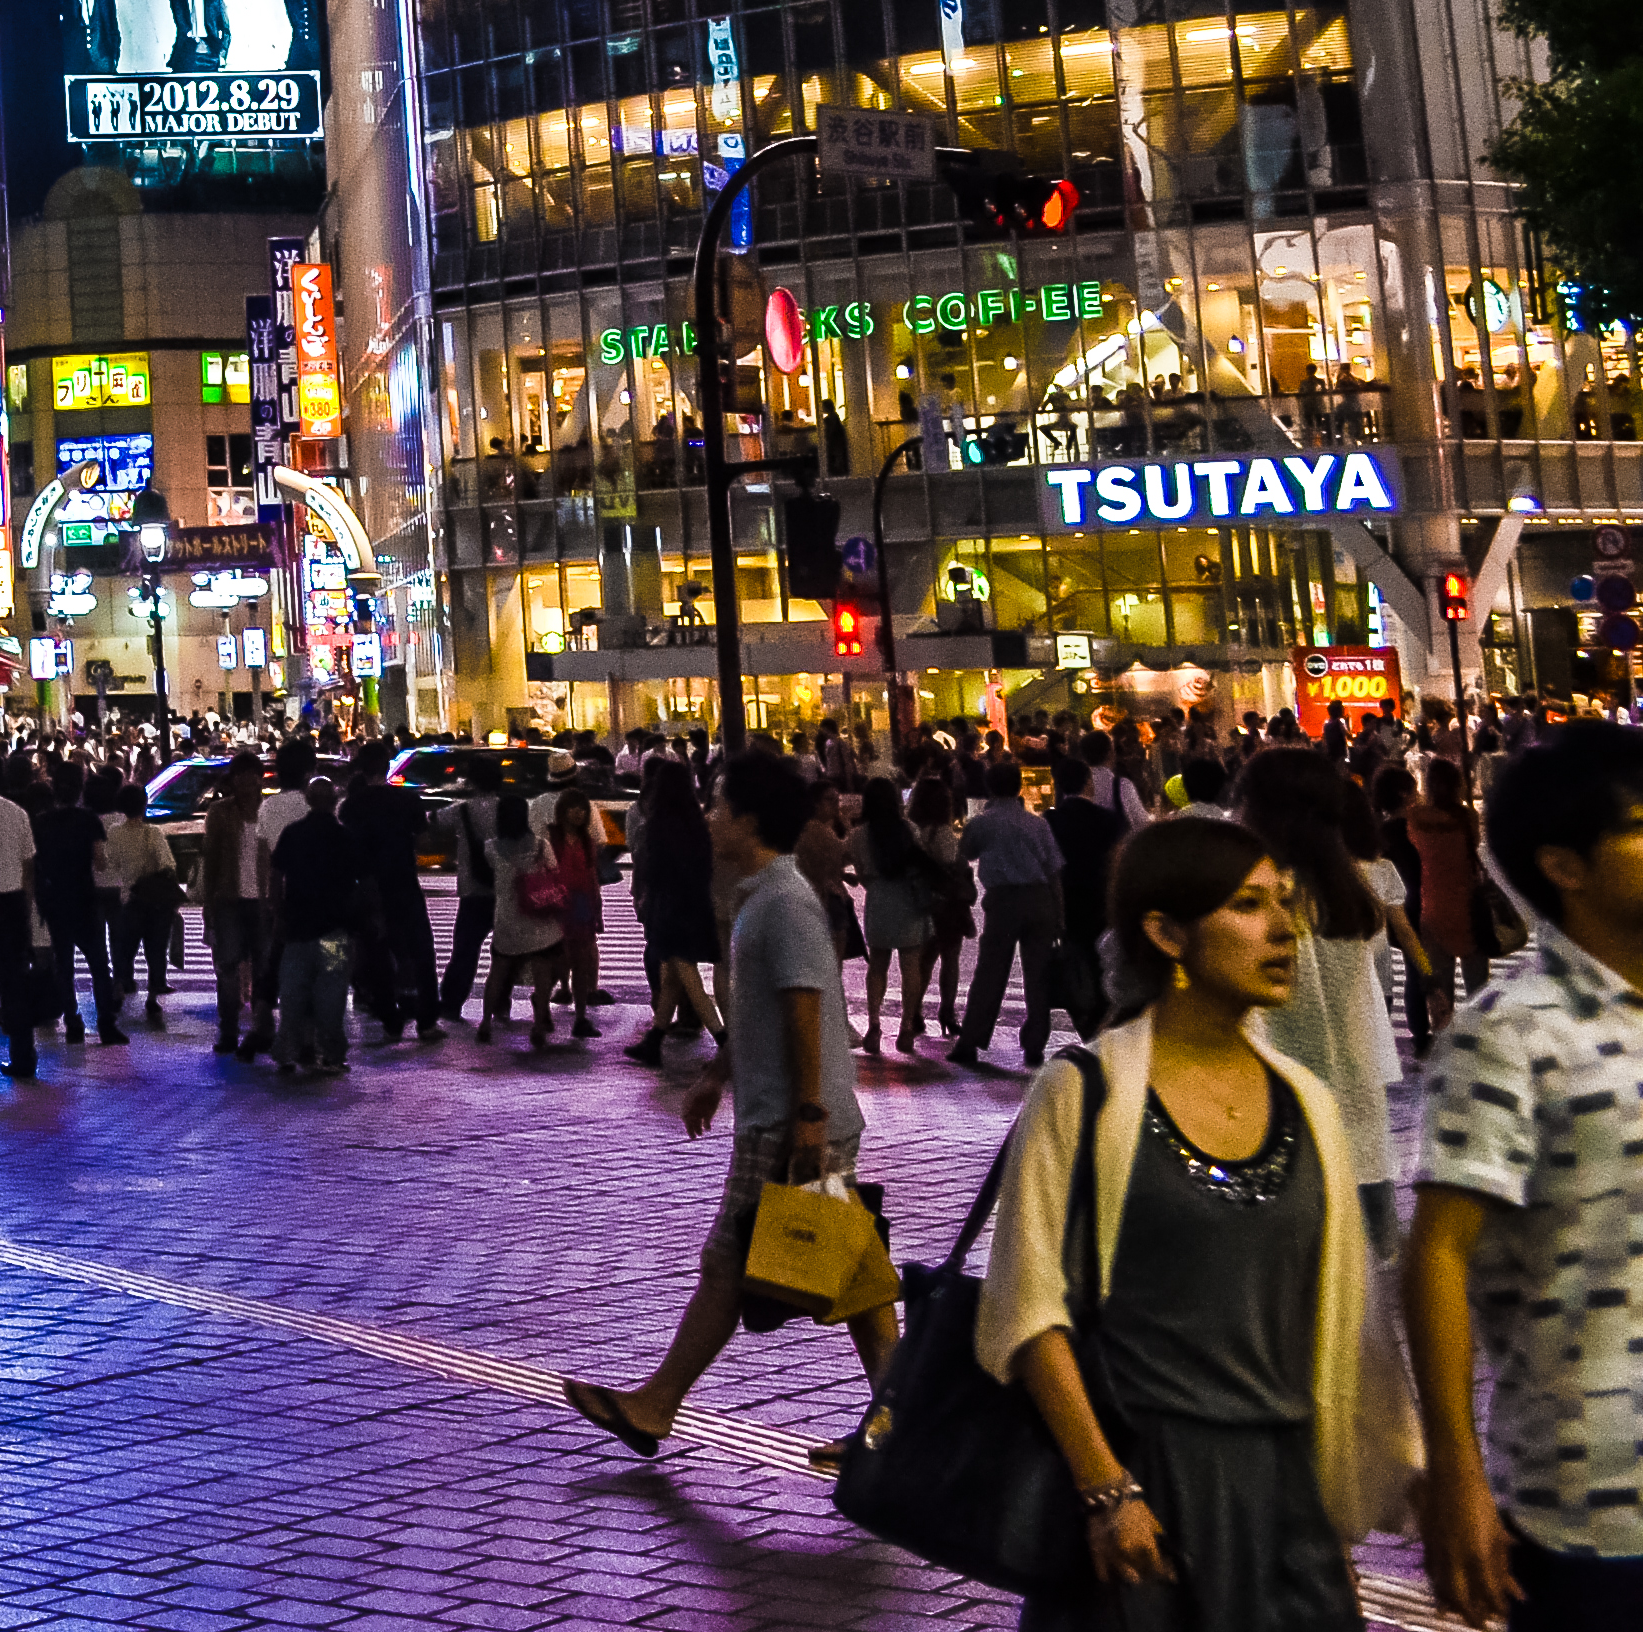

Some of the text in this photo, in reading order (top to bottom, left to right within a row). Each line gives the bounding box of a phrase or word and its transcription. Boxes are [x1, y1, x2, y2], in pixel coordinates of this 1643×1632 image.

[144, 78, 301, 112] 2012.8.29
[145, 111, 301, 133] MAJOR DEBUT
[1046, 452, 1394, 527] TSUTAYA
